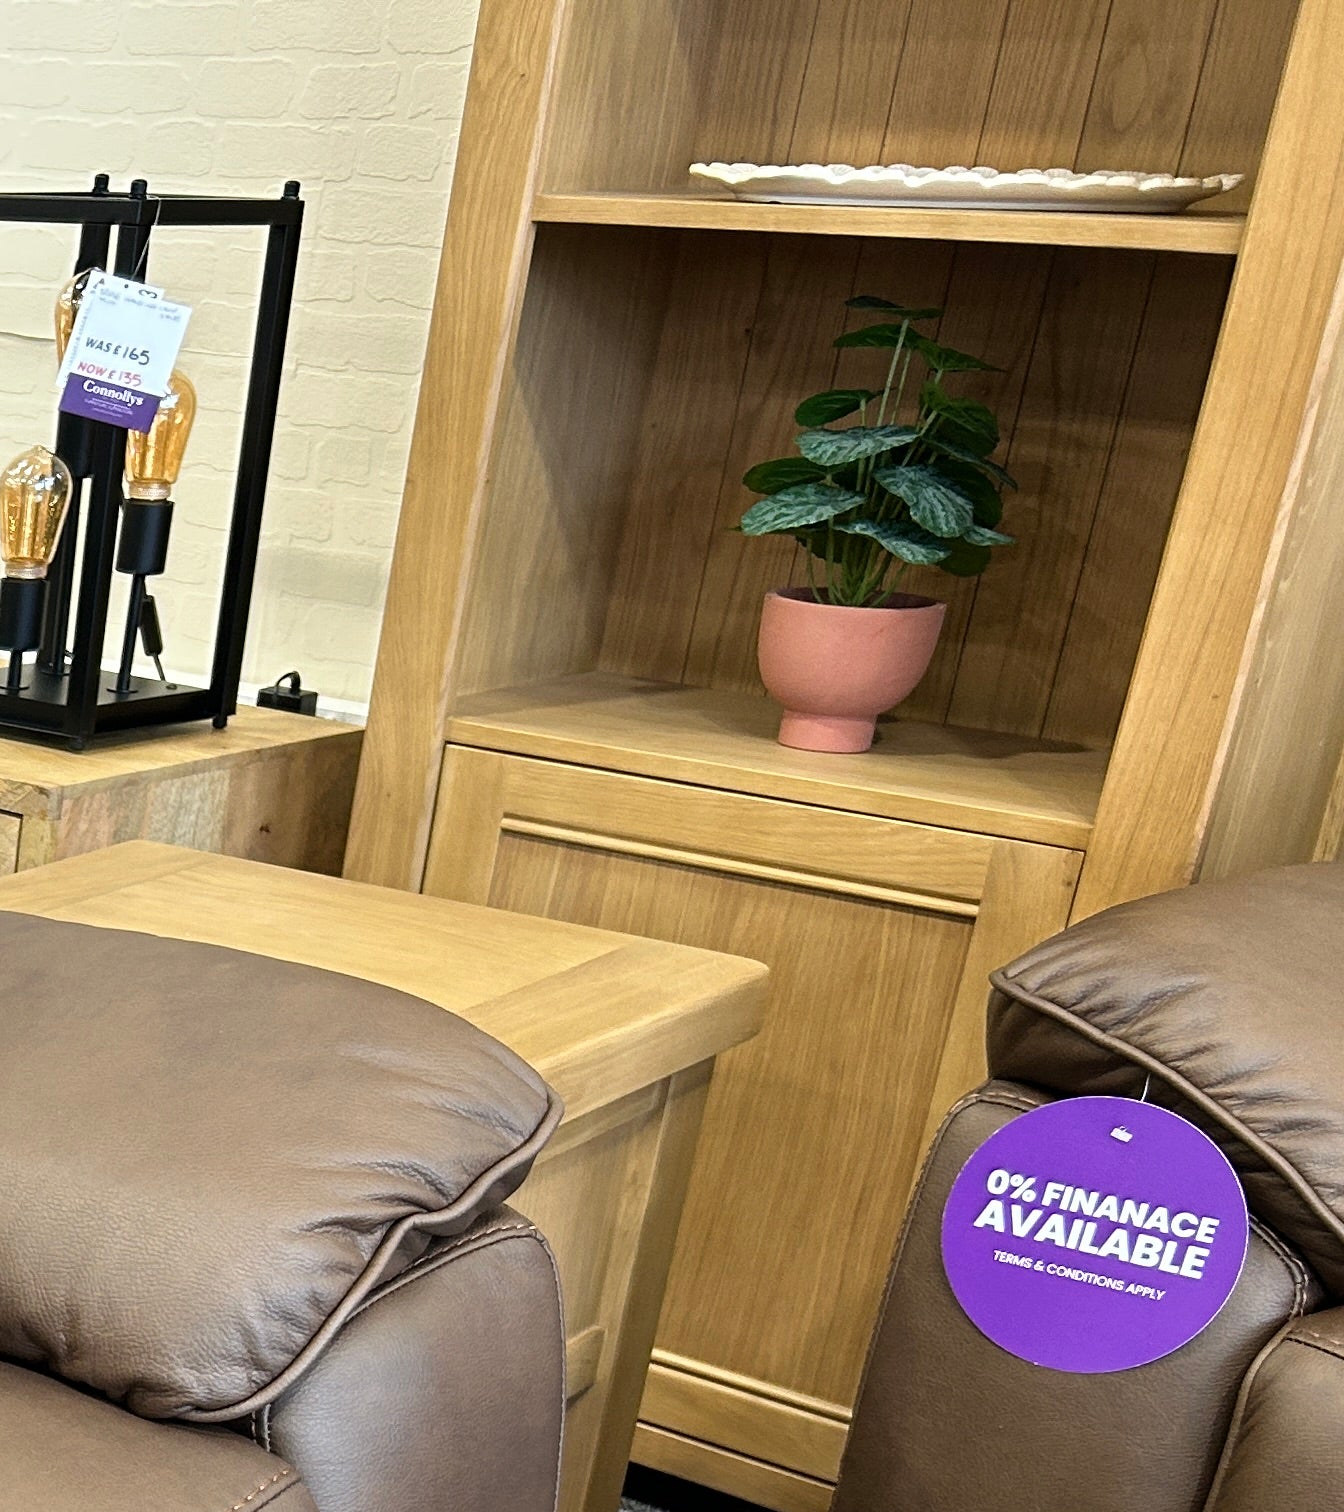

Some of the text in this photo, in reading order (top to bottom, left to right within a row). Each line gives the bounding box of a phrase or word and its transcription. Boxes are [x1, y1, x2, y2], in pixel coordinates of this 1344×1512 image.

[77, 361, 108, 376] NOW
[86, 337, 150, 366] WAS £165
[83, 379, 144, 407] Connollys
[986, 1168, 1220, 1244] 0% FINANACE
[973, 1199, 1211, 1280] AVAILABLE
[993, 1250, 1166, 1301] TERMS & CONDITIONS APPLY
